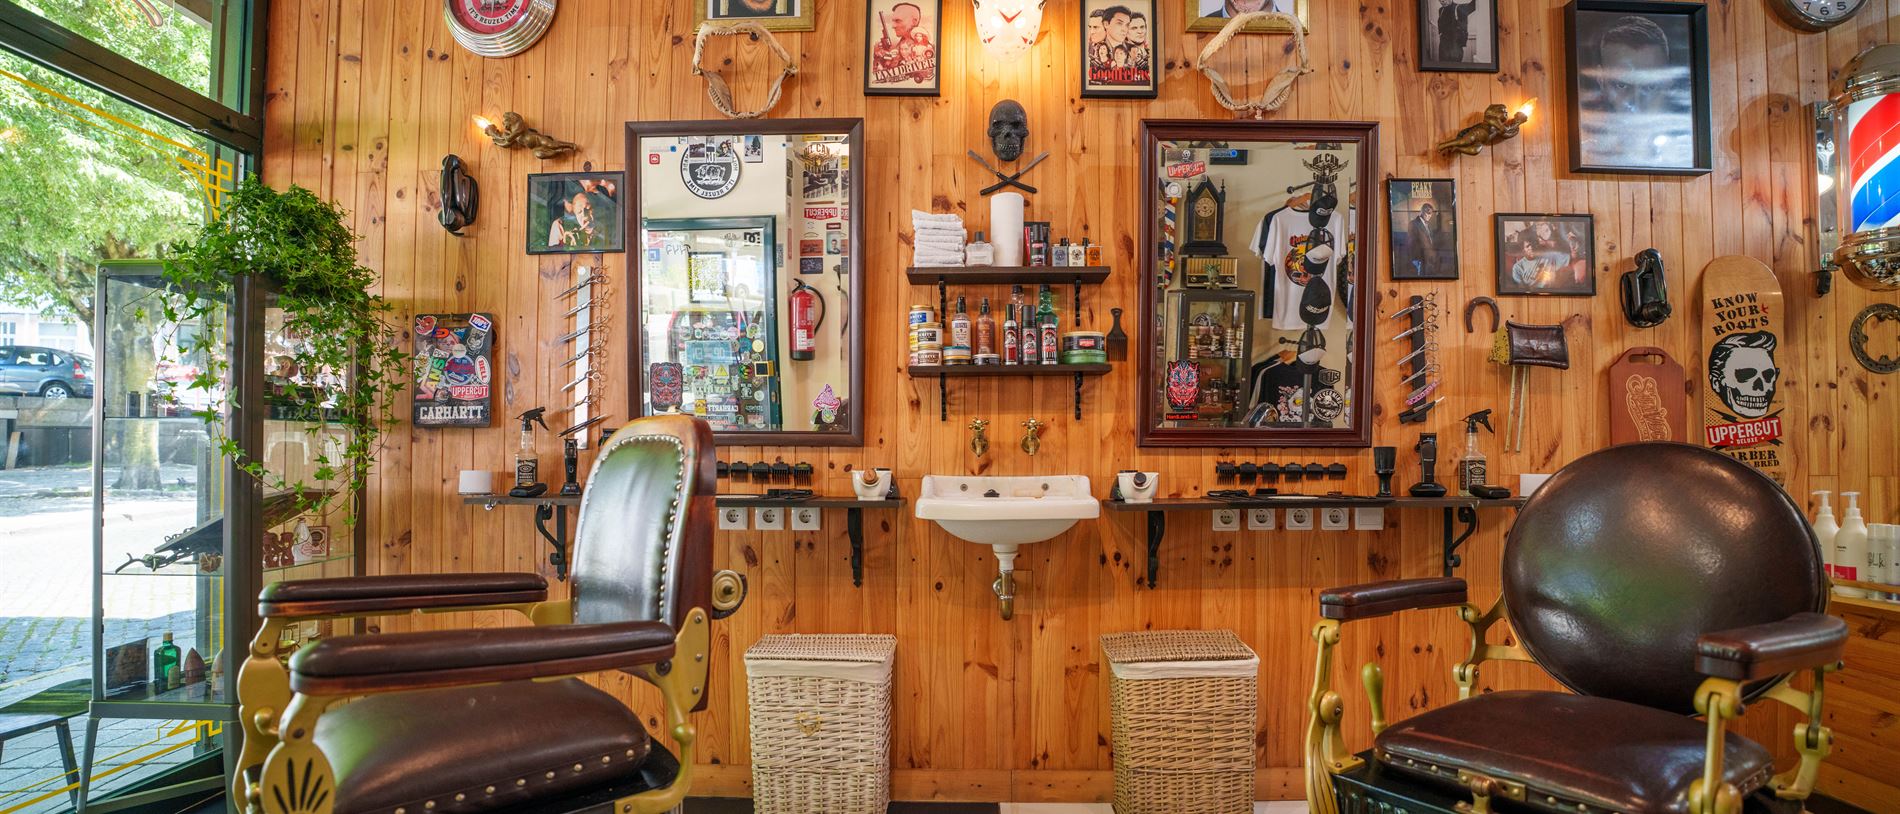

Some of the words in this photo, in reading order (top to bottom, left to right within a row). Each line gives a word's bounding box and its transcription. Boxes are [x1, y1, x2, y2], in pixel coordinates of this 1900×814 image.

[1803, 2, 1811, 11] 7
[1820, 6, 1829, 15] 6
[1836, 2, 1846, 10] 5
[468, 7, 478, 19] IT'S
[479, 17, 505, 25] REUZEL
[505, 5, 520, 19] TIME
[875, 67, 898, 81] TAXI
[899, 57, 936, 75] DRIVER
[1411, 181, 1433, 191] PEAKY
[1711, 292, 1758, 310] KNOW
[1715, 304, 1761, 322] YOUR
[1711, 315, 1769, 337] ROOTS
[478, 358, 488, 380] BELL
[452, 386, 487, 397] UPPERCUT
[419, 405, 484, 420] CARHARTT
[1709, 419, 1779, 444] UPPERCUT
[1730, 449, 1777, 461] ARBER
[1754, 459, 1780, 468] BRED
